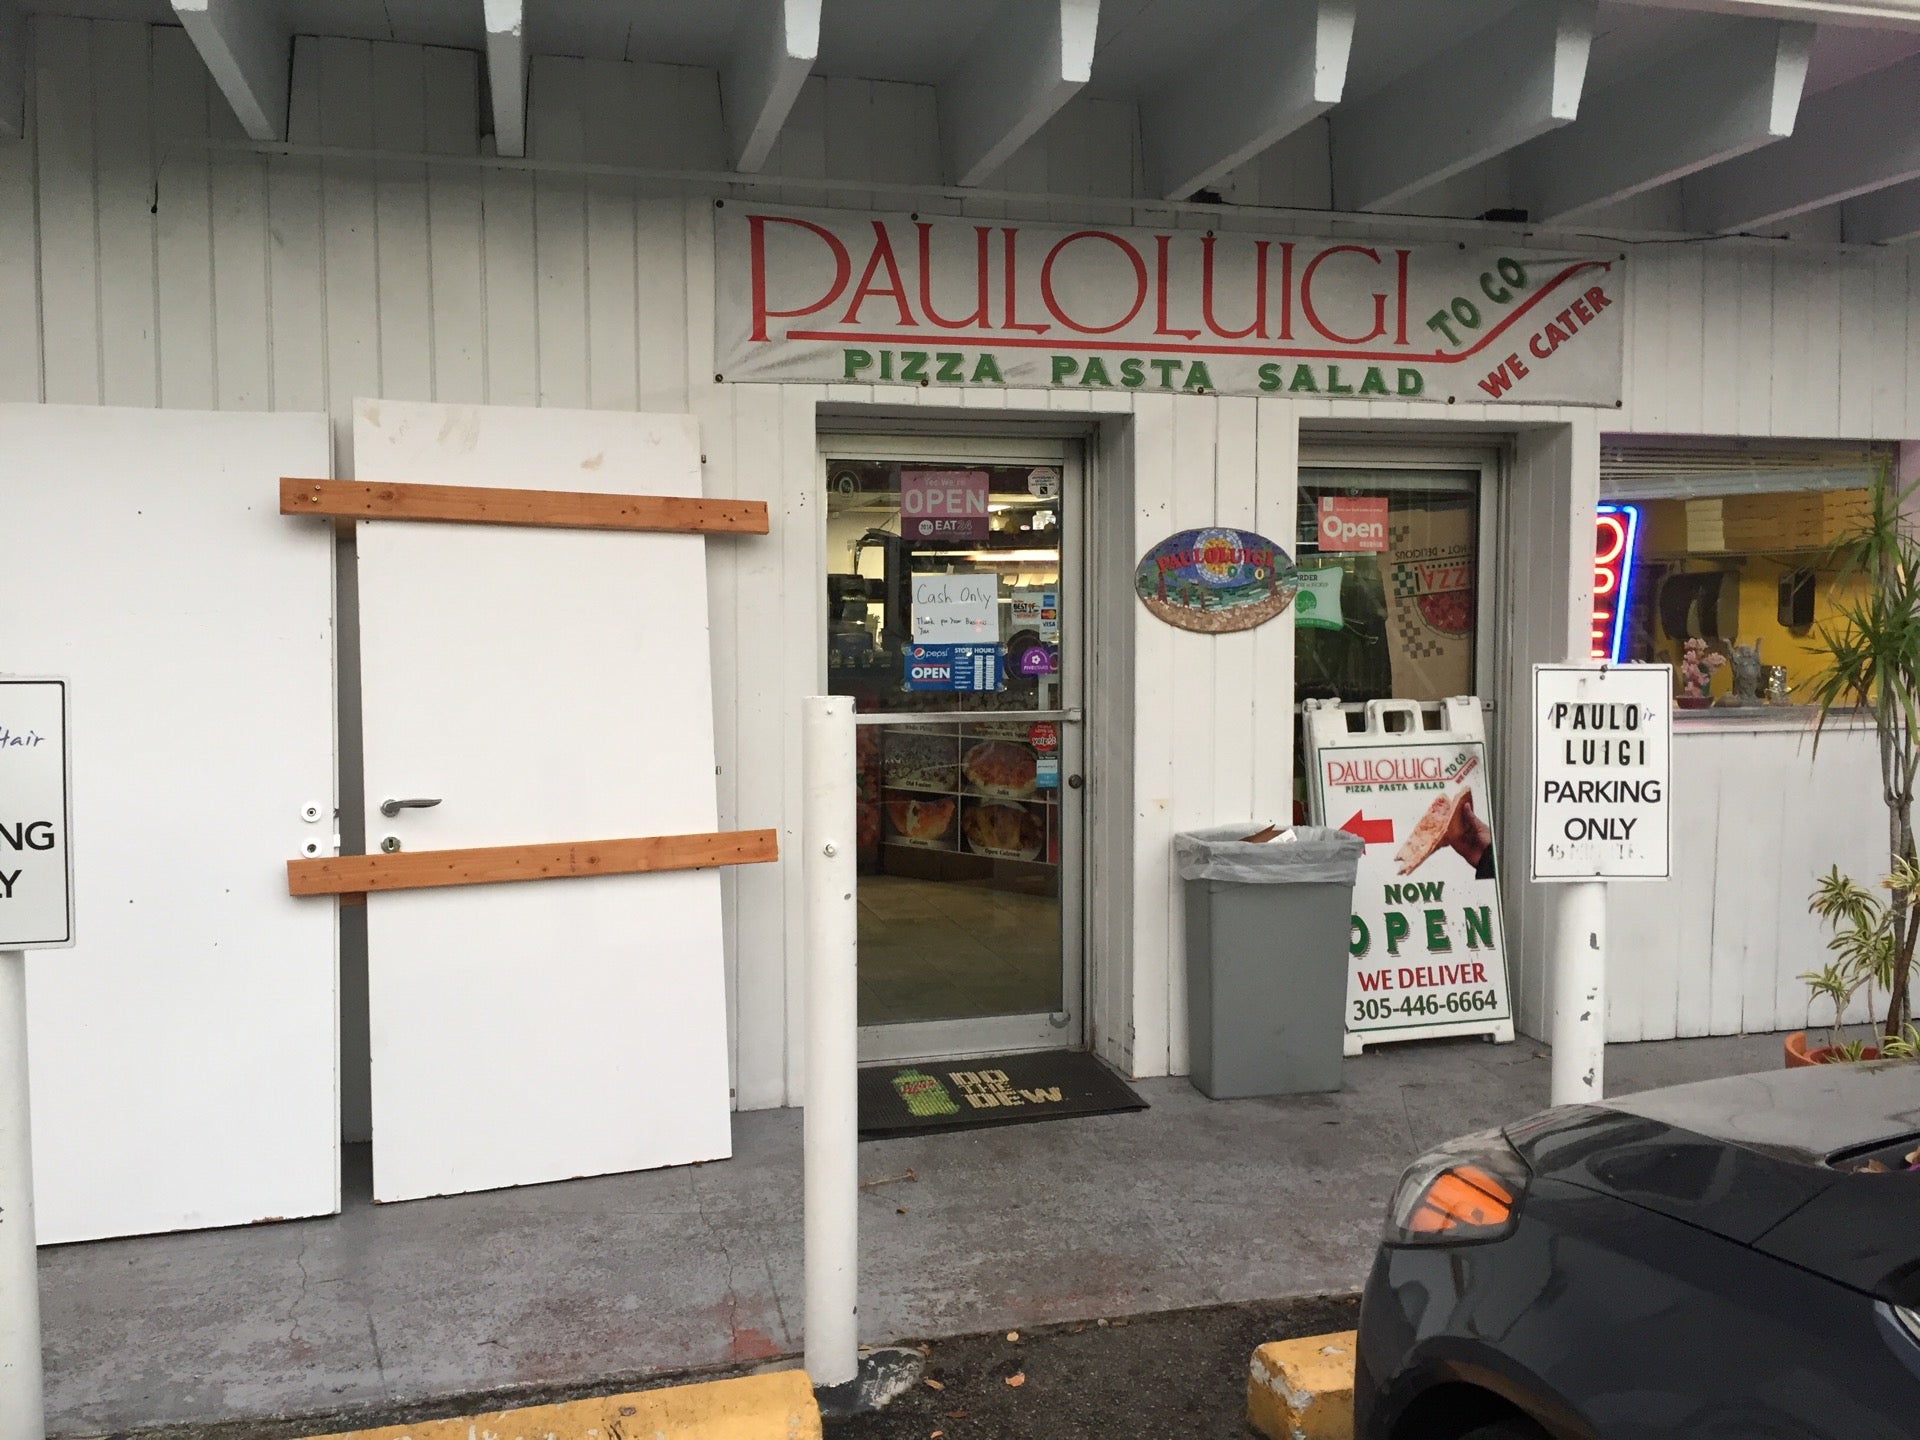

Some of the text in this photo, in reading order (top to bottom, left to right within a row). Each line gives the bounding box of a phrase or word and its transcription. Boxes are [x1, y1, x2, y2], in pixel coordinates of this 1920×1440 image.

[745, 215, 1412, 345] PAULOLUIGI
[1426, 257, 1527, 347] TO GO
[1478, 286, 1612, 399] WE CATER
[843, 349, 1425, 397] PIZZA PASTA SALAD
[904, 488, 985, 514] OPEN
[1323, 516, 1383, 543] Open
[1157, 547, 1274, 573] PAULOLUIGI
[1395, 544, 1467, 561] HOT DELICIOUS
[1414, 563, 1467, 592] ZZA!
[917, 583, 991, 609] Cash Only
[926, 647, 949, 658] pepsi
[974, 647, 995, 655] HOURS
[911, 667, 951, 679] OPEN
[1555, 703, 1639, 731] PAULO
[1445, 753, 1467, 776] TO GO
[1565, 740, 1645, 766] LUIGI
[1327, 757, 1443, 786] PAULOLUIGI
[1346, 782, 1445, 793] PIZZA PASTA SALAD
[1544, 780, 1661, 803] PARKING
[1564, 817, 1638, 840] ONLY
[1384, 881, 1445, 905] NOW
[1350, 905, 1496, 959] OPEN
[1358, 962, 1488, 992] WE DELIVER
[1353, 990, 1498, 1021] 305-446-6664
[964, 1087, 1062, 1109] DEW
